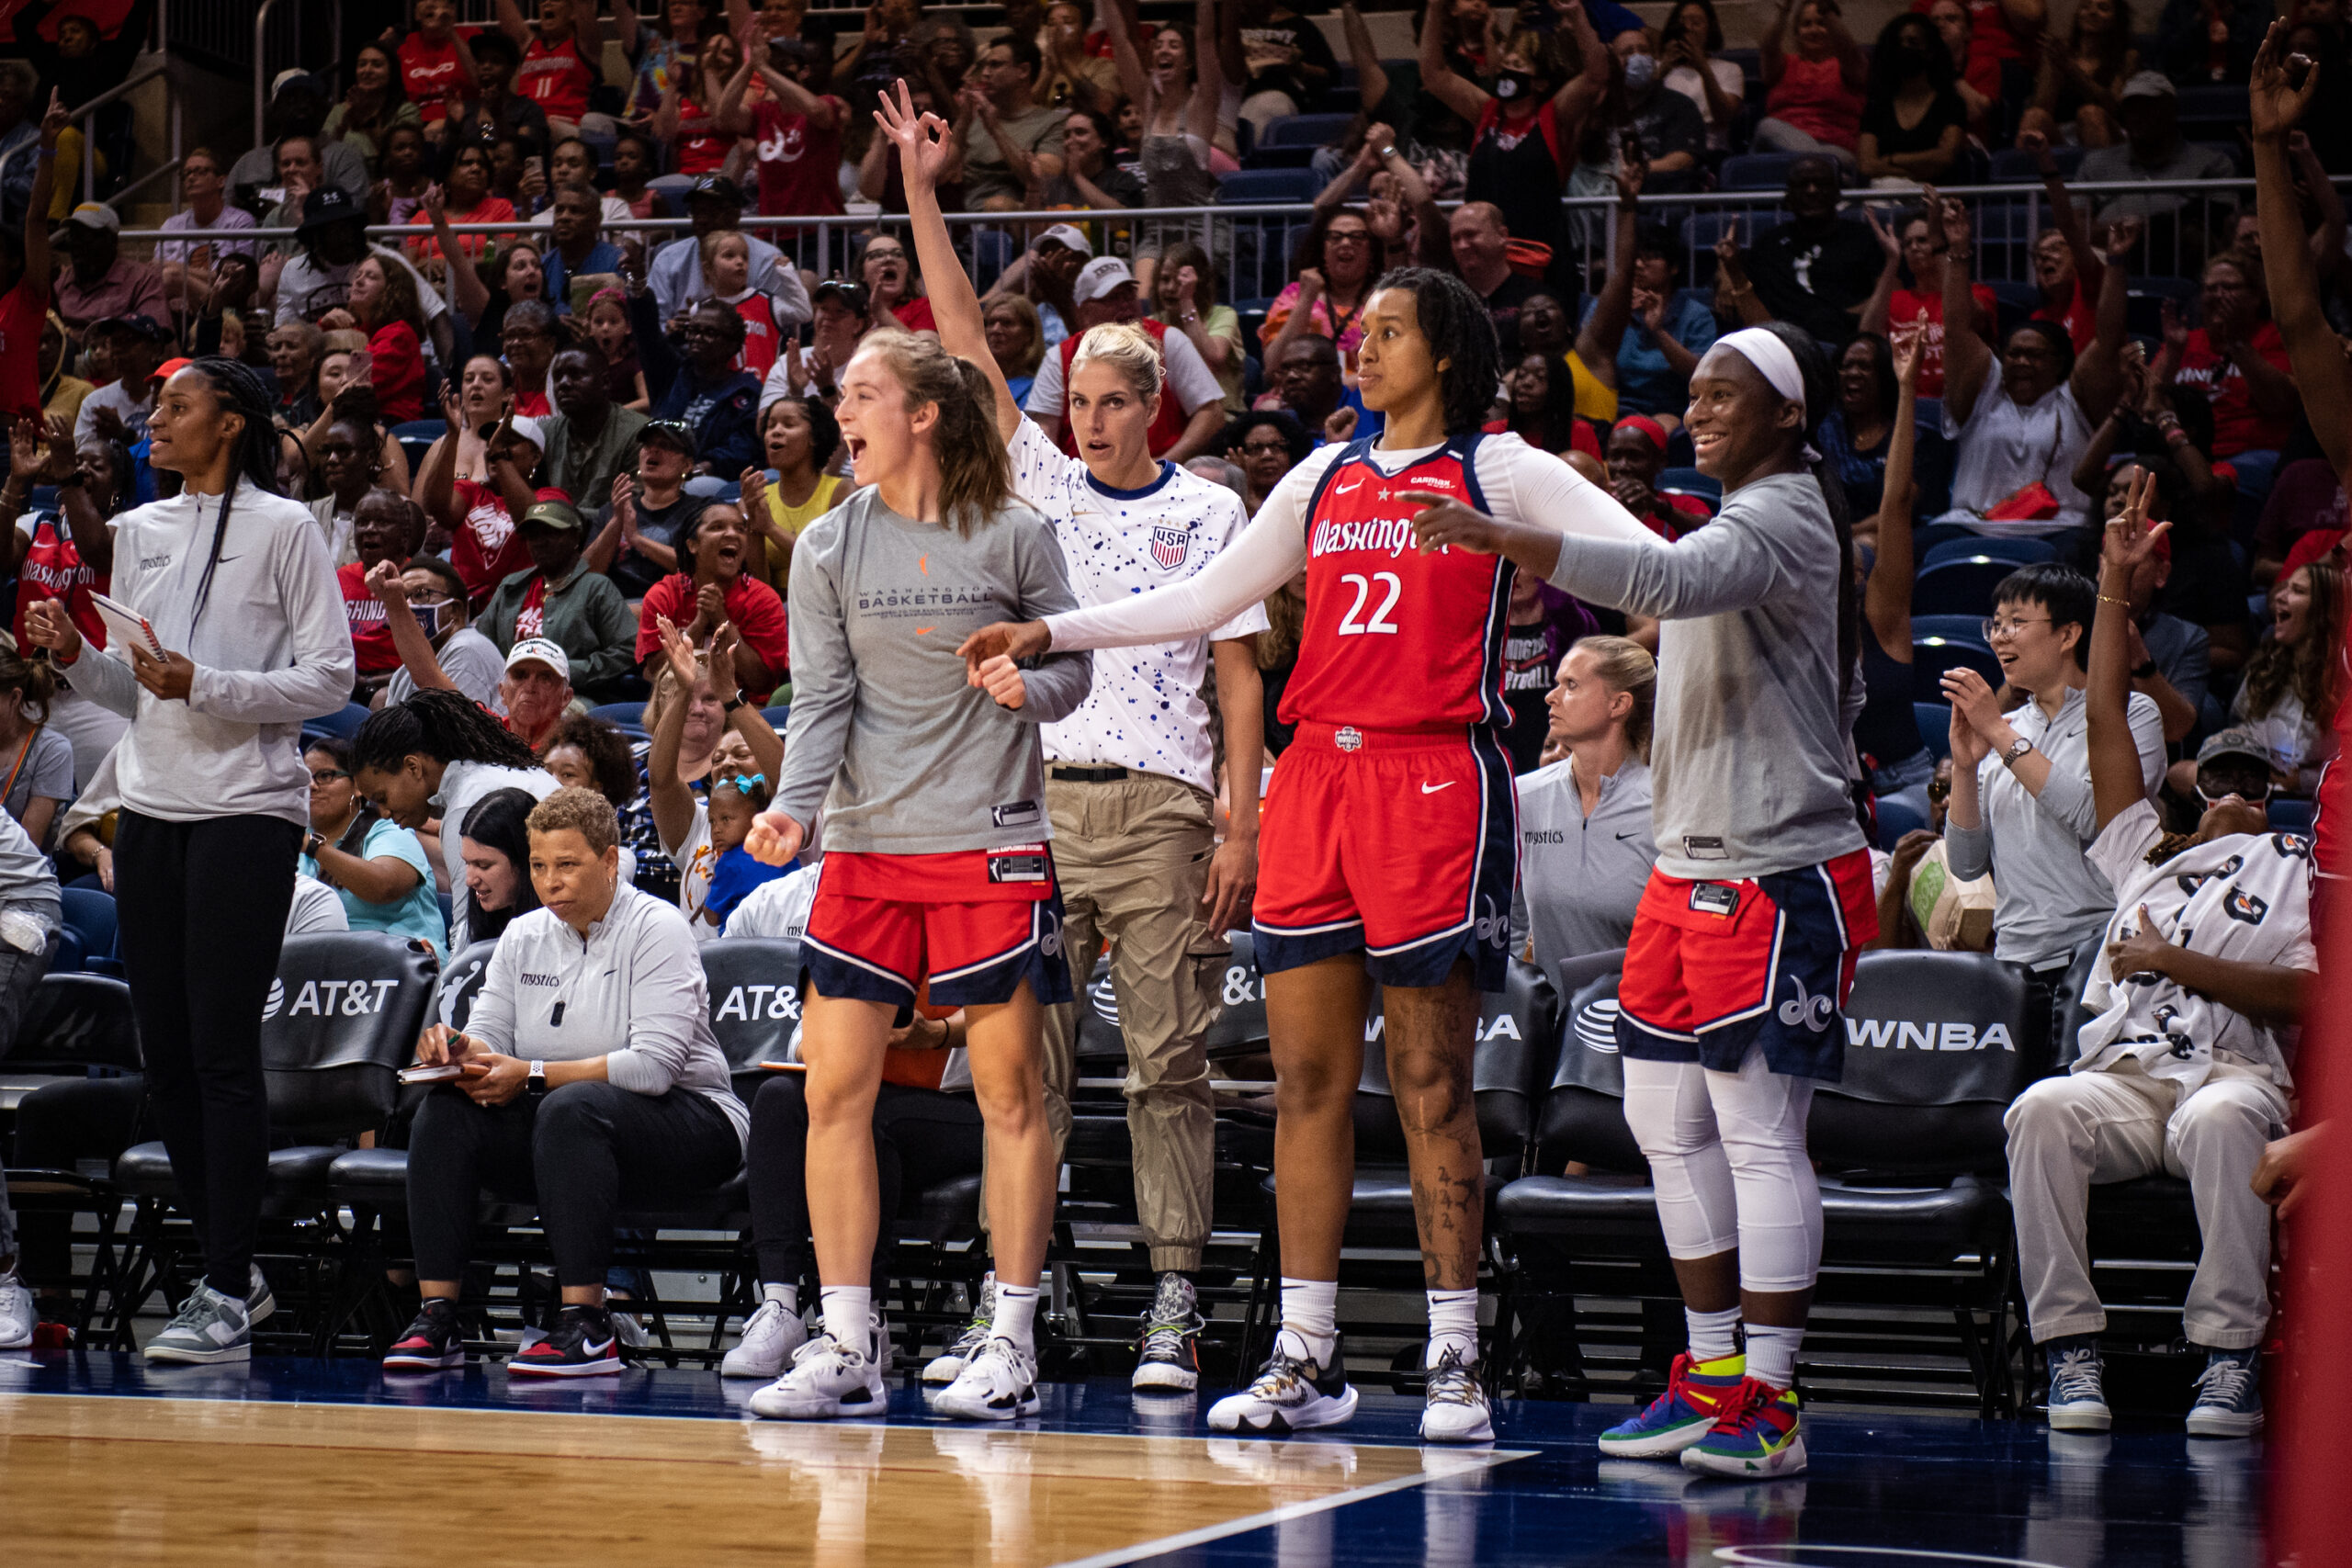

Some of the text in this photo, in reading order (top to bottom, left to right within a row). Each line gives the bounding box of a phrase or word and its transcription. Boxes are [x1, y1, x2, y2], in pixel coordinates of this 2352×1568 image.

[1157, 529, 1186, 547] USA
[859, 585, 994, 598] WASHINGTON
[858, 592, 993, 610] BASKETBALL
[1338, 571, 1402, 637] 22
[1524, 829, 1564, 845] mystics
[520, 972, 560, 987] mystics
[288, 979, 400, 1017] AT&T
[1845, 1017, 2016, 1053] WNBA
